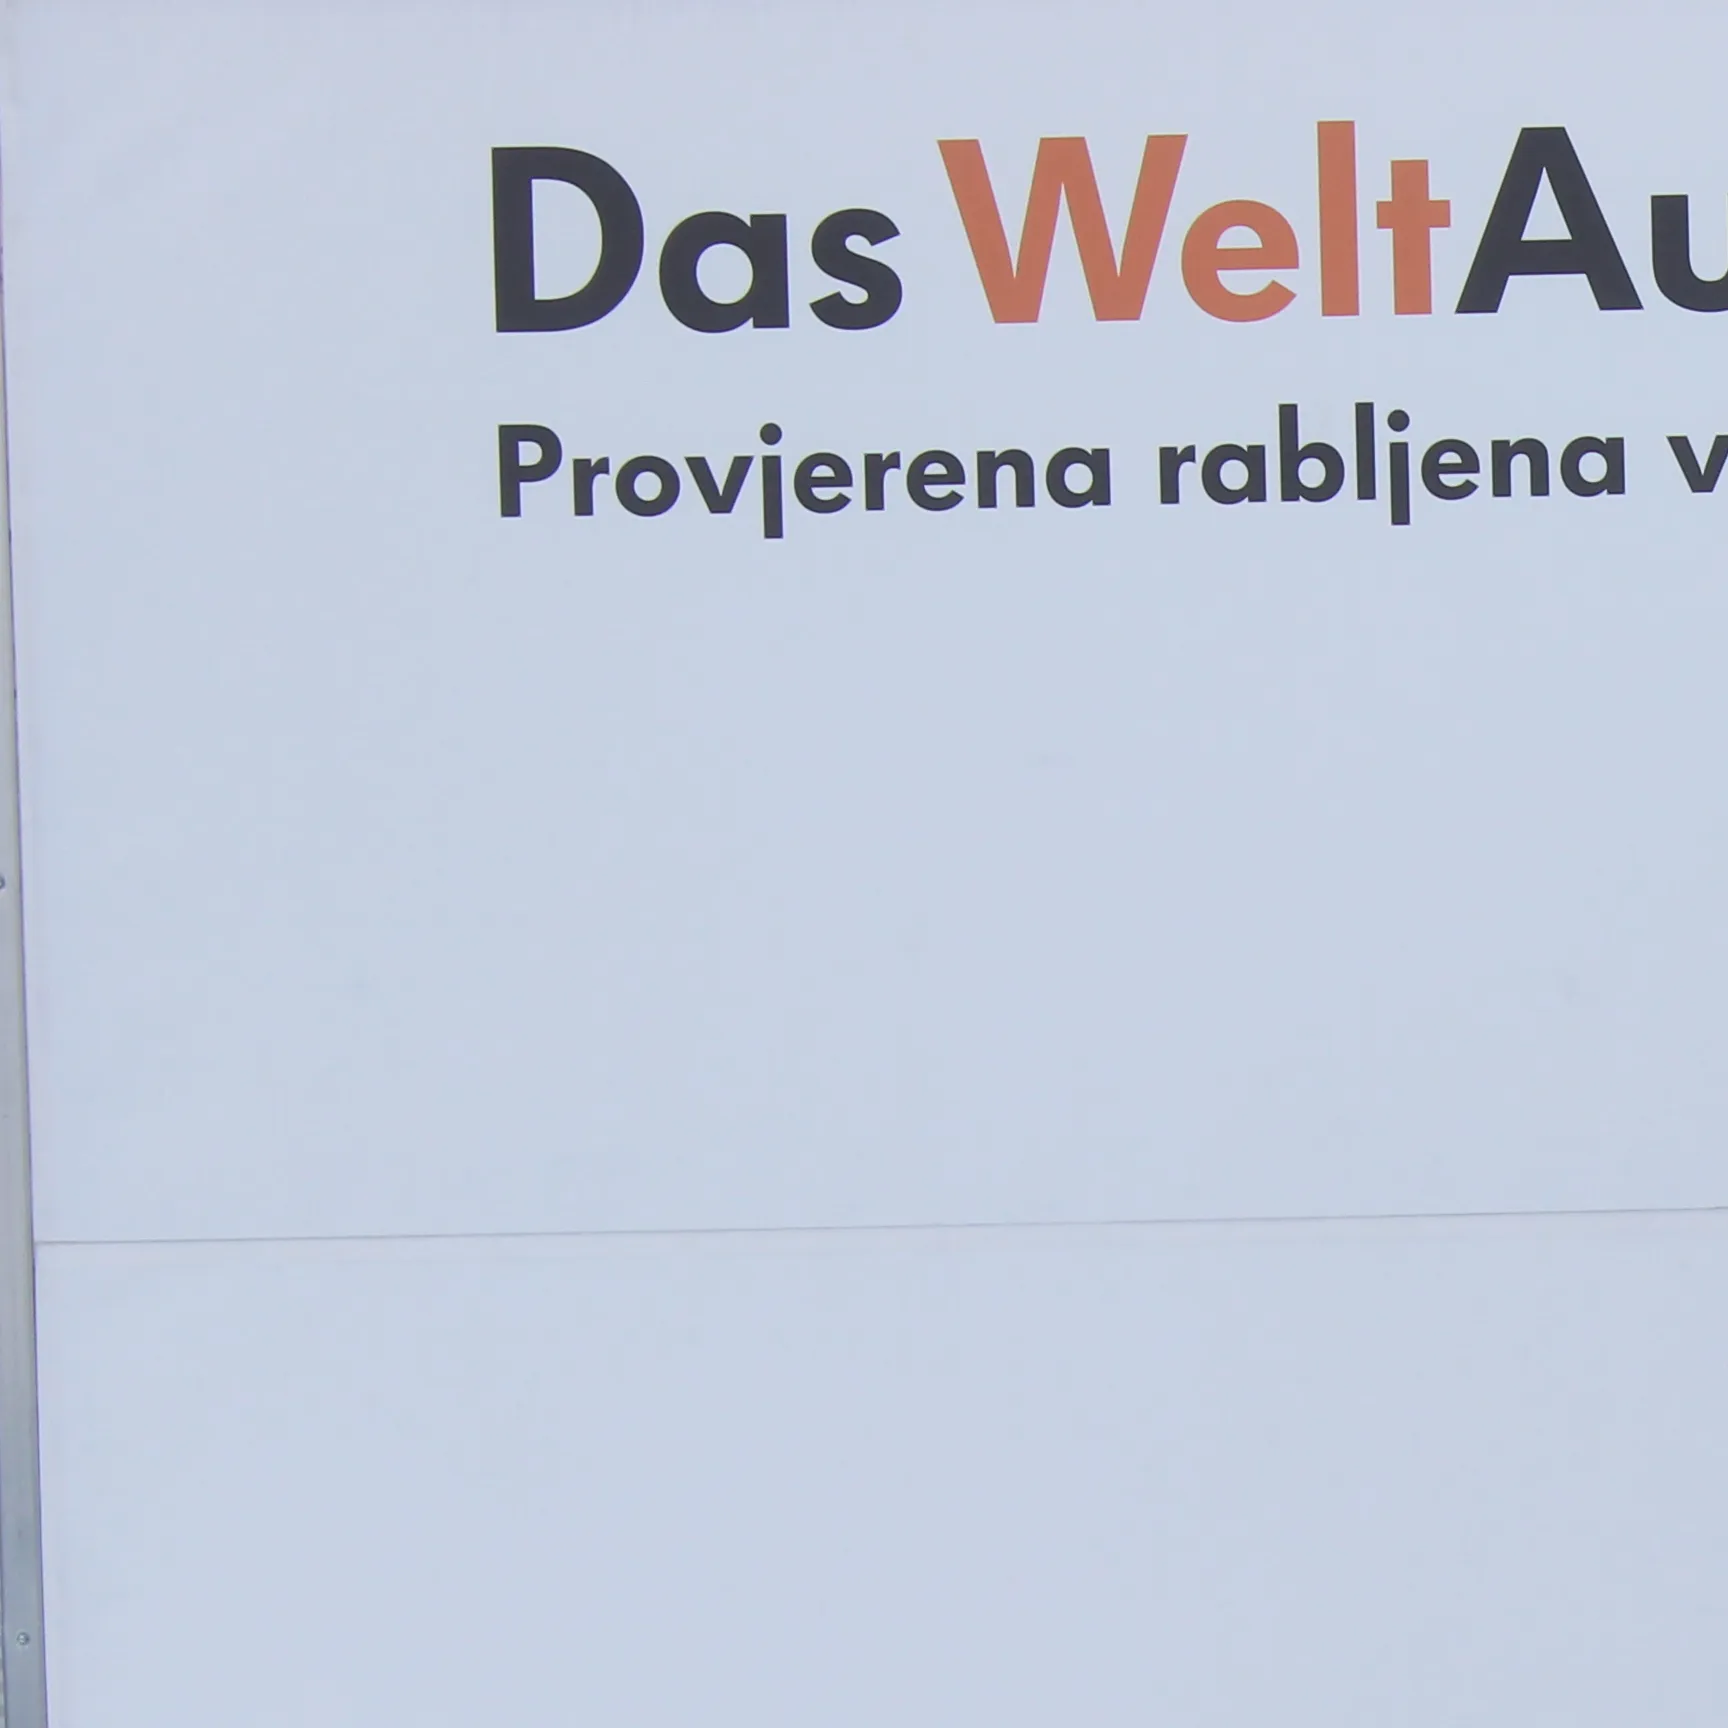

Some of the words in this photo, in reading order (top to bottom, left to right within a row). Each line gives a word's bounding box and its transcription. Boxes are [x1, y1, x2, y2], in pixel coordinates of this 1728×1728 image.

[492, 147, 902, 333] Das
[499, 423, 1111, 539] Provjerena
[1159, 402, 1625, 525] rabljena
